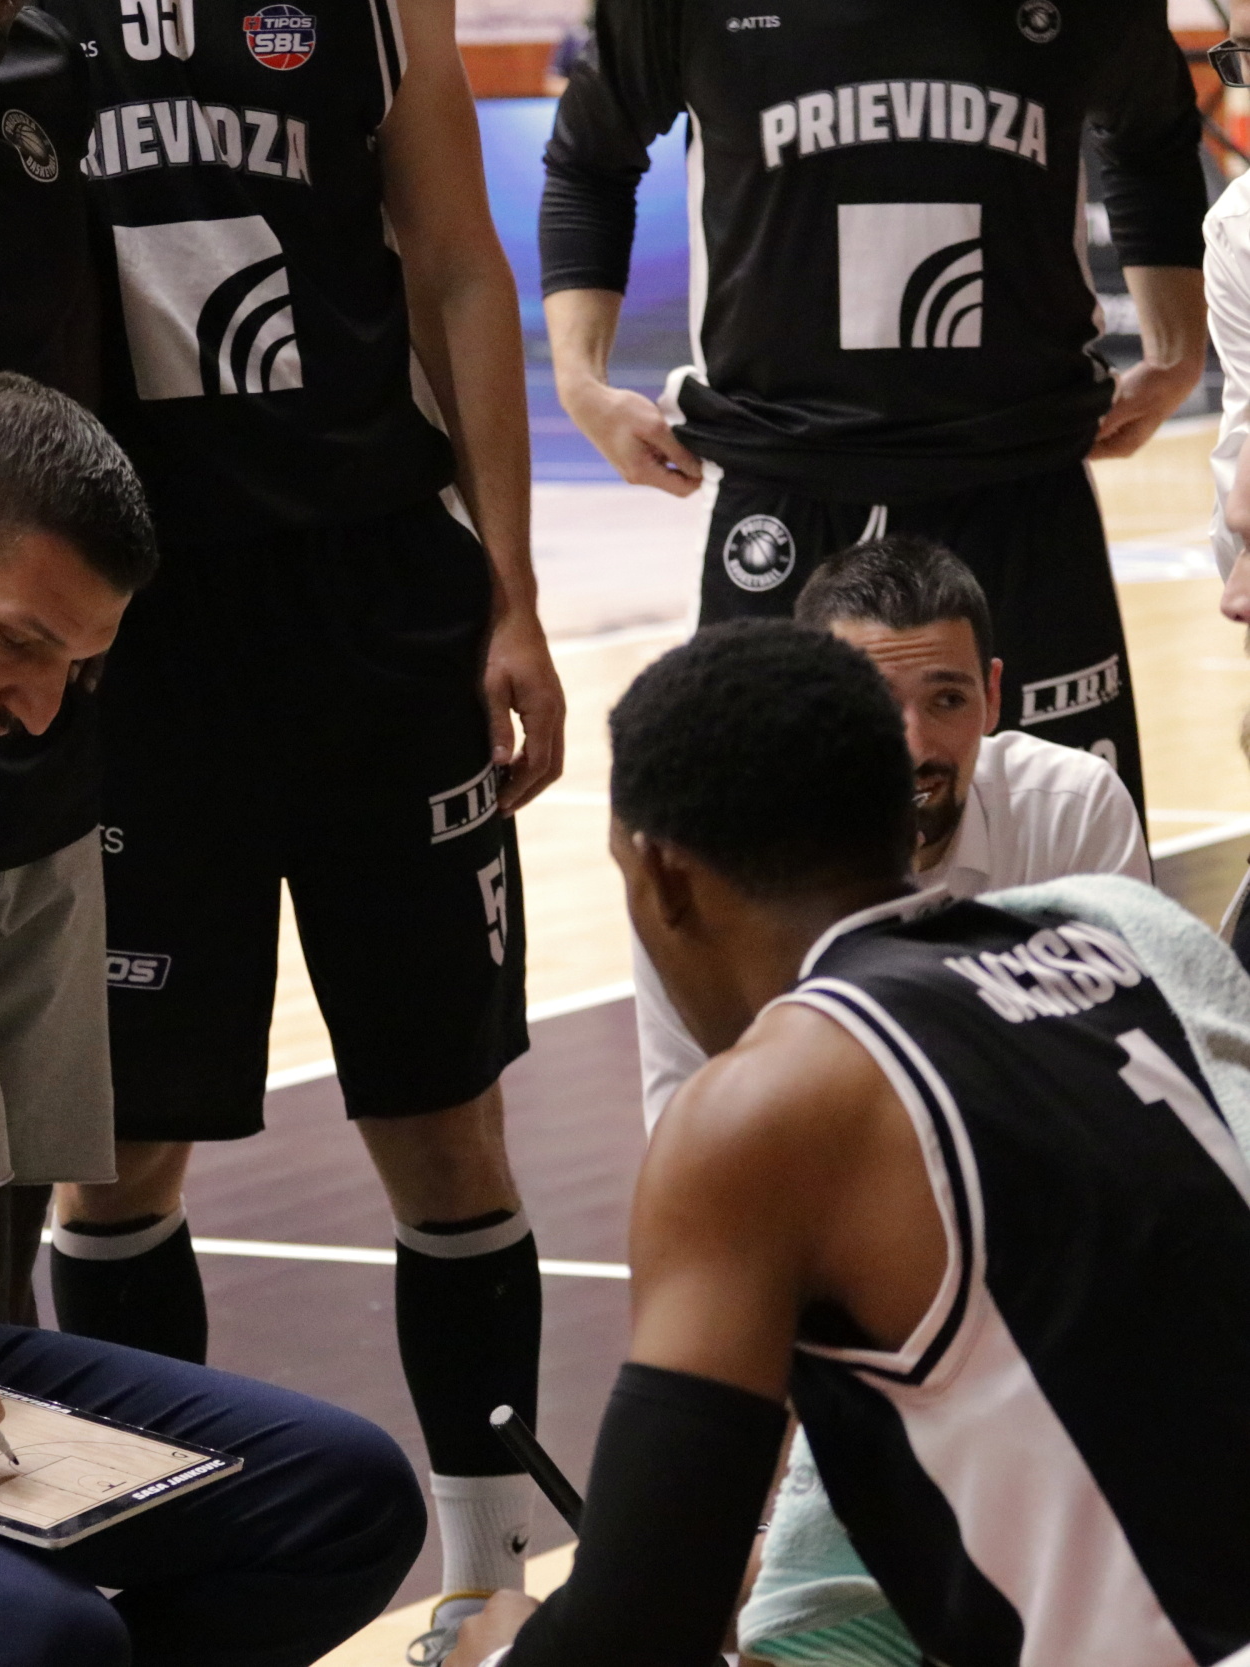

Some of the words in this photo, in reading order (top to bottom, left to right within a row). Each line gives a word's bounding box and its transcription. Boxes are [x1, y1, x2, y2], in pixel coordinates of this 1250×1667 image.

[263, 17, 312, 28] TIPOS
[740, 15, 781, 30] ATTIS
[254, 33, 310, 53] SBL
[760, 80, 1048, 169] PRIEVIDZA
